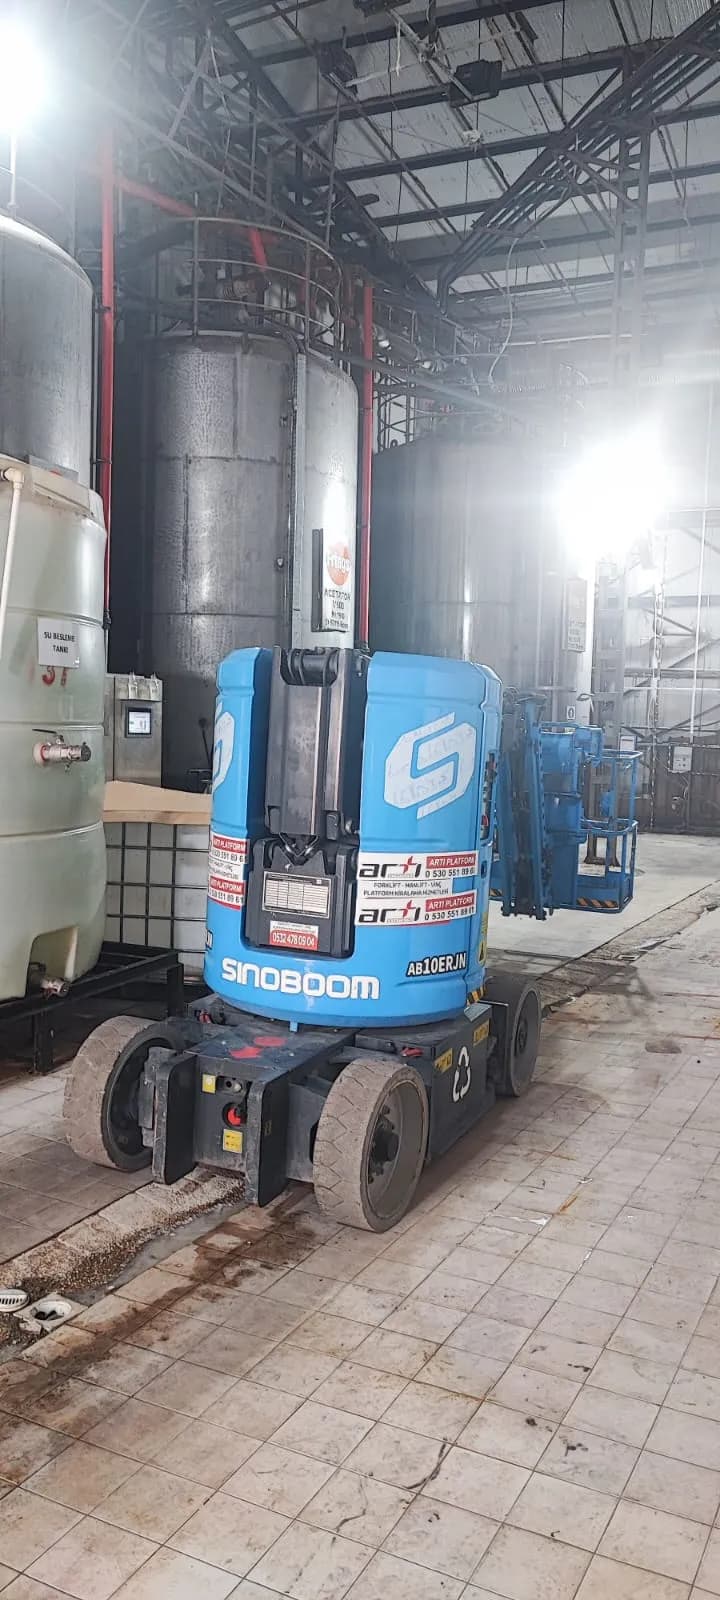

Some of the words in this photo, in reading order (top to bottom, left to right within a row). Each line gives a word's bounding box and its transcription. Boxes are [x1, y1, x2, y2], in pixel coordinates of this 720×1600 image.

[53, 633, 75, 642] BESLEME
[433, 869, 446, 877] 530
[448, 868, 460, 877] 551
[432, 912, 445, 920] 530
[447, 911, 459, 919] 551
[272, 932, 286, 943] 0532
[287, 934, 298, 945] 478
[299, 936, 307, 946] 09
[407, 953, 466, 976] AB10ERJN
[222, 959, 380, 1000] SINOBOOM
